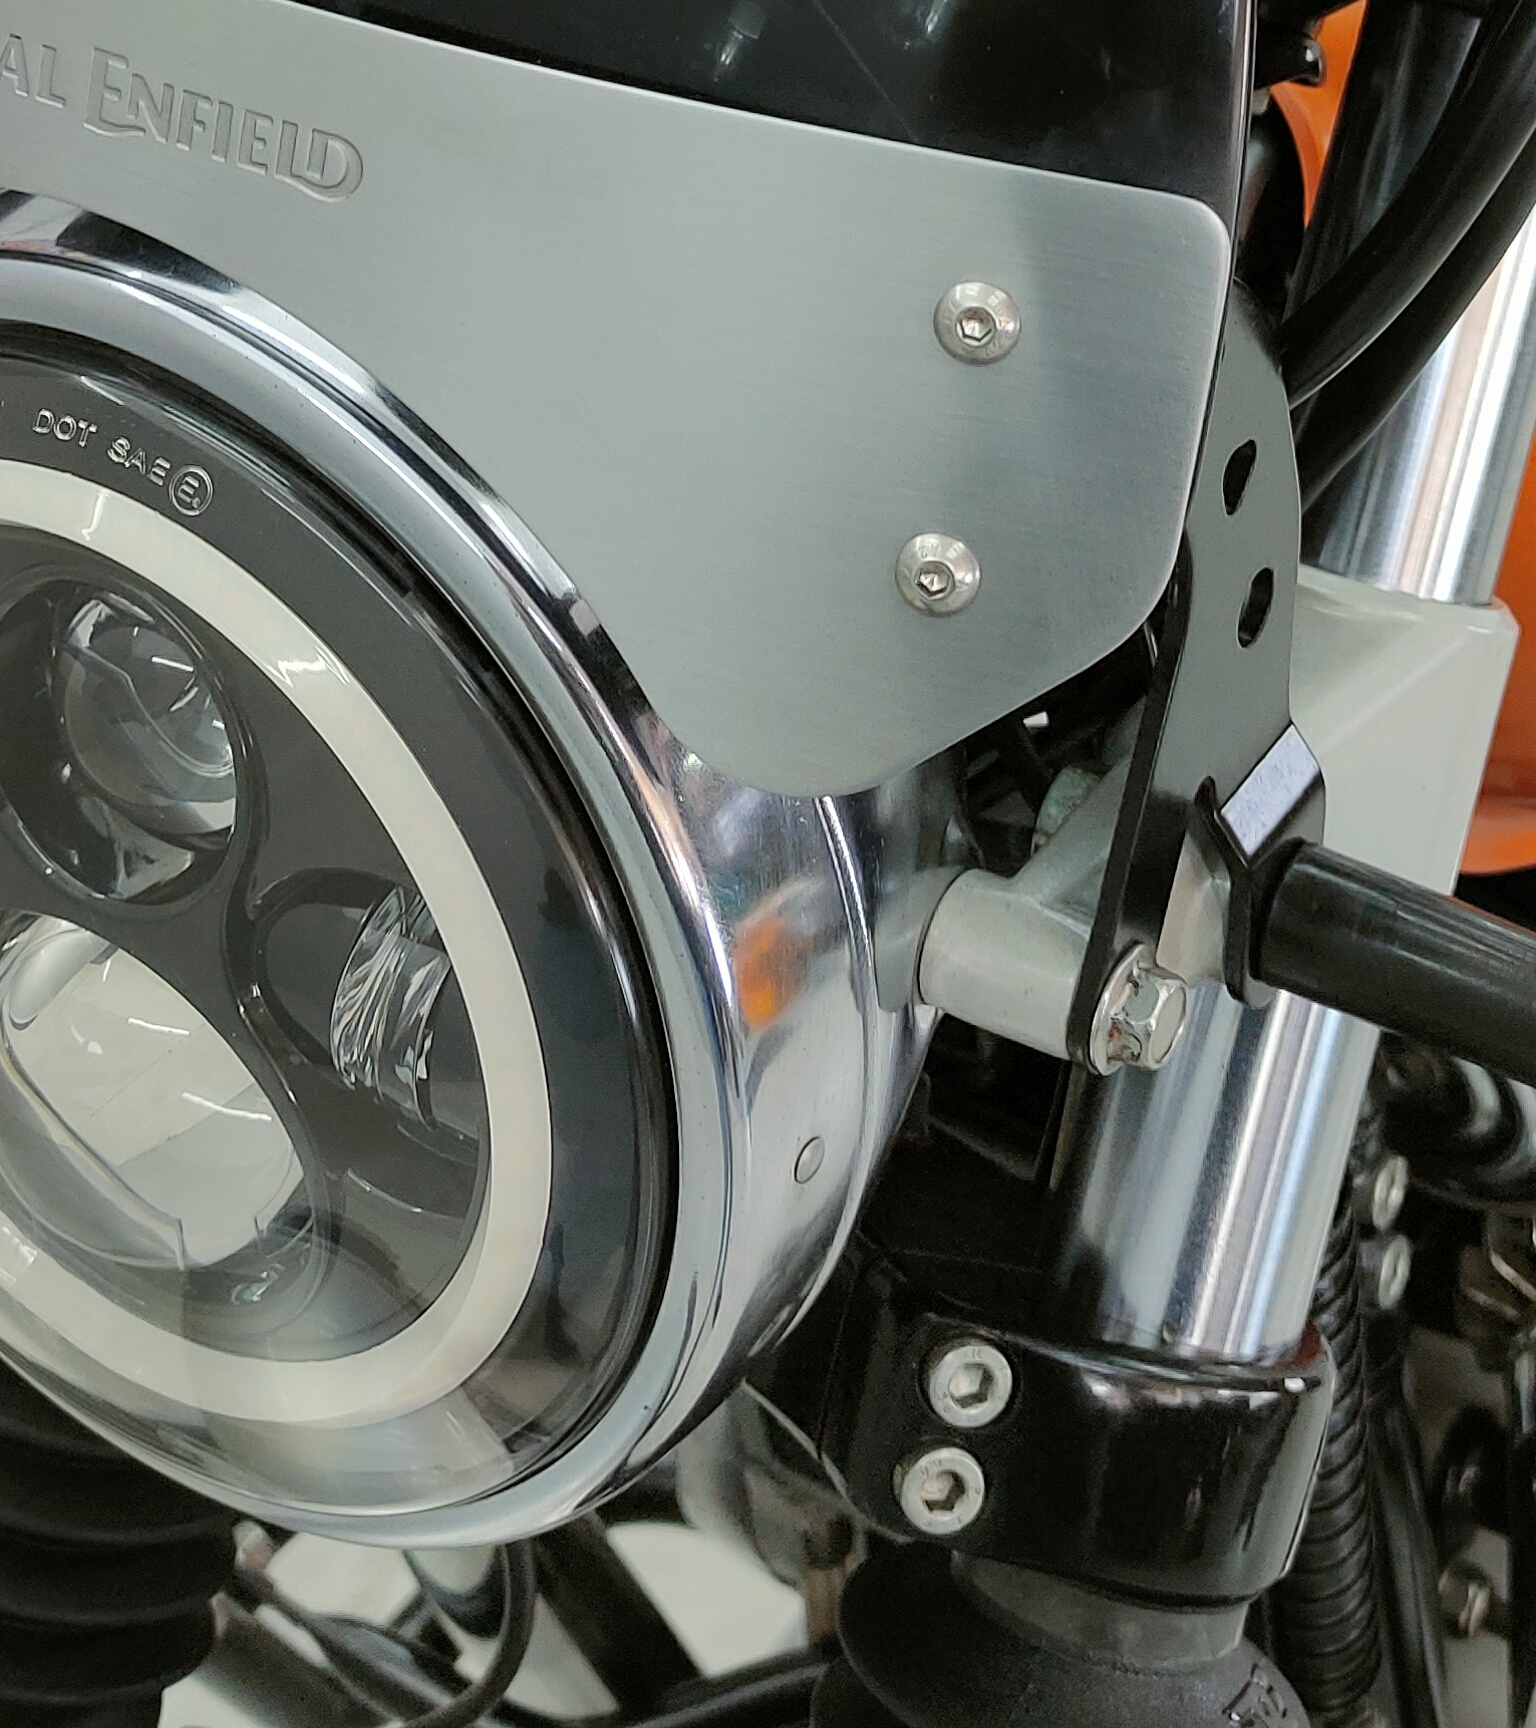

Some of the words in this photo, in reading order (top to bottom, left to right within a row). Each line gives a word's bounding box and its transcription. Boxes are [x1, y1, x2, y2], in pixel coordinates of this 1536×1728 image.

[82, 46, 364, 204] ENFIELD
[32, 408, 98, 448] DOT
[106, 436, 172, 487] SAE
